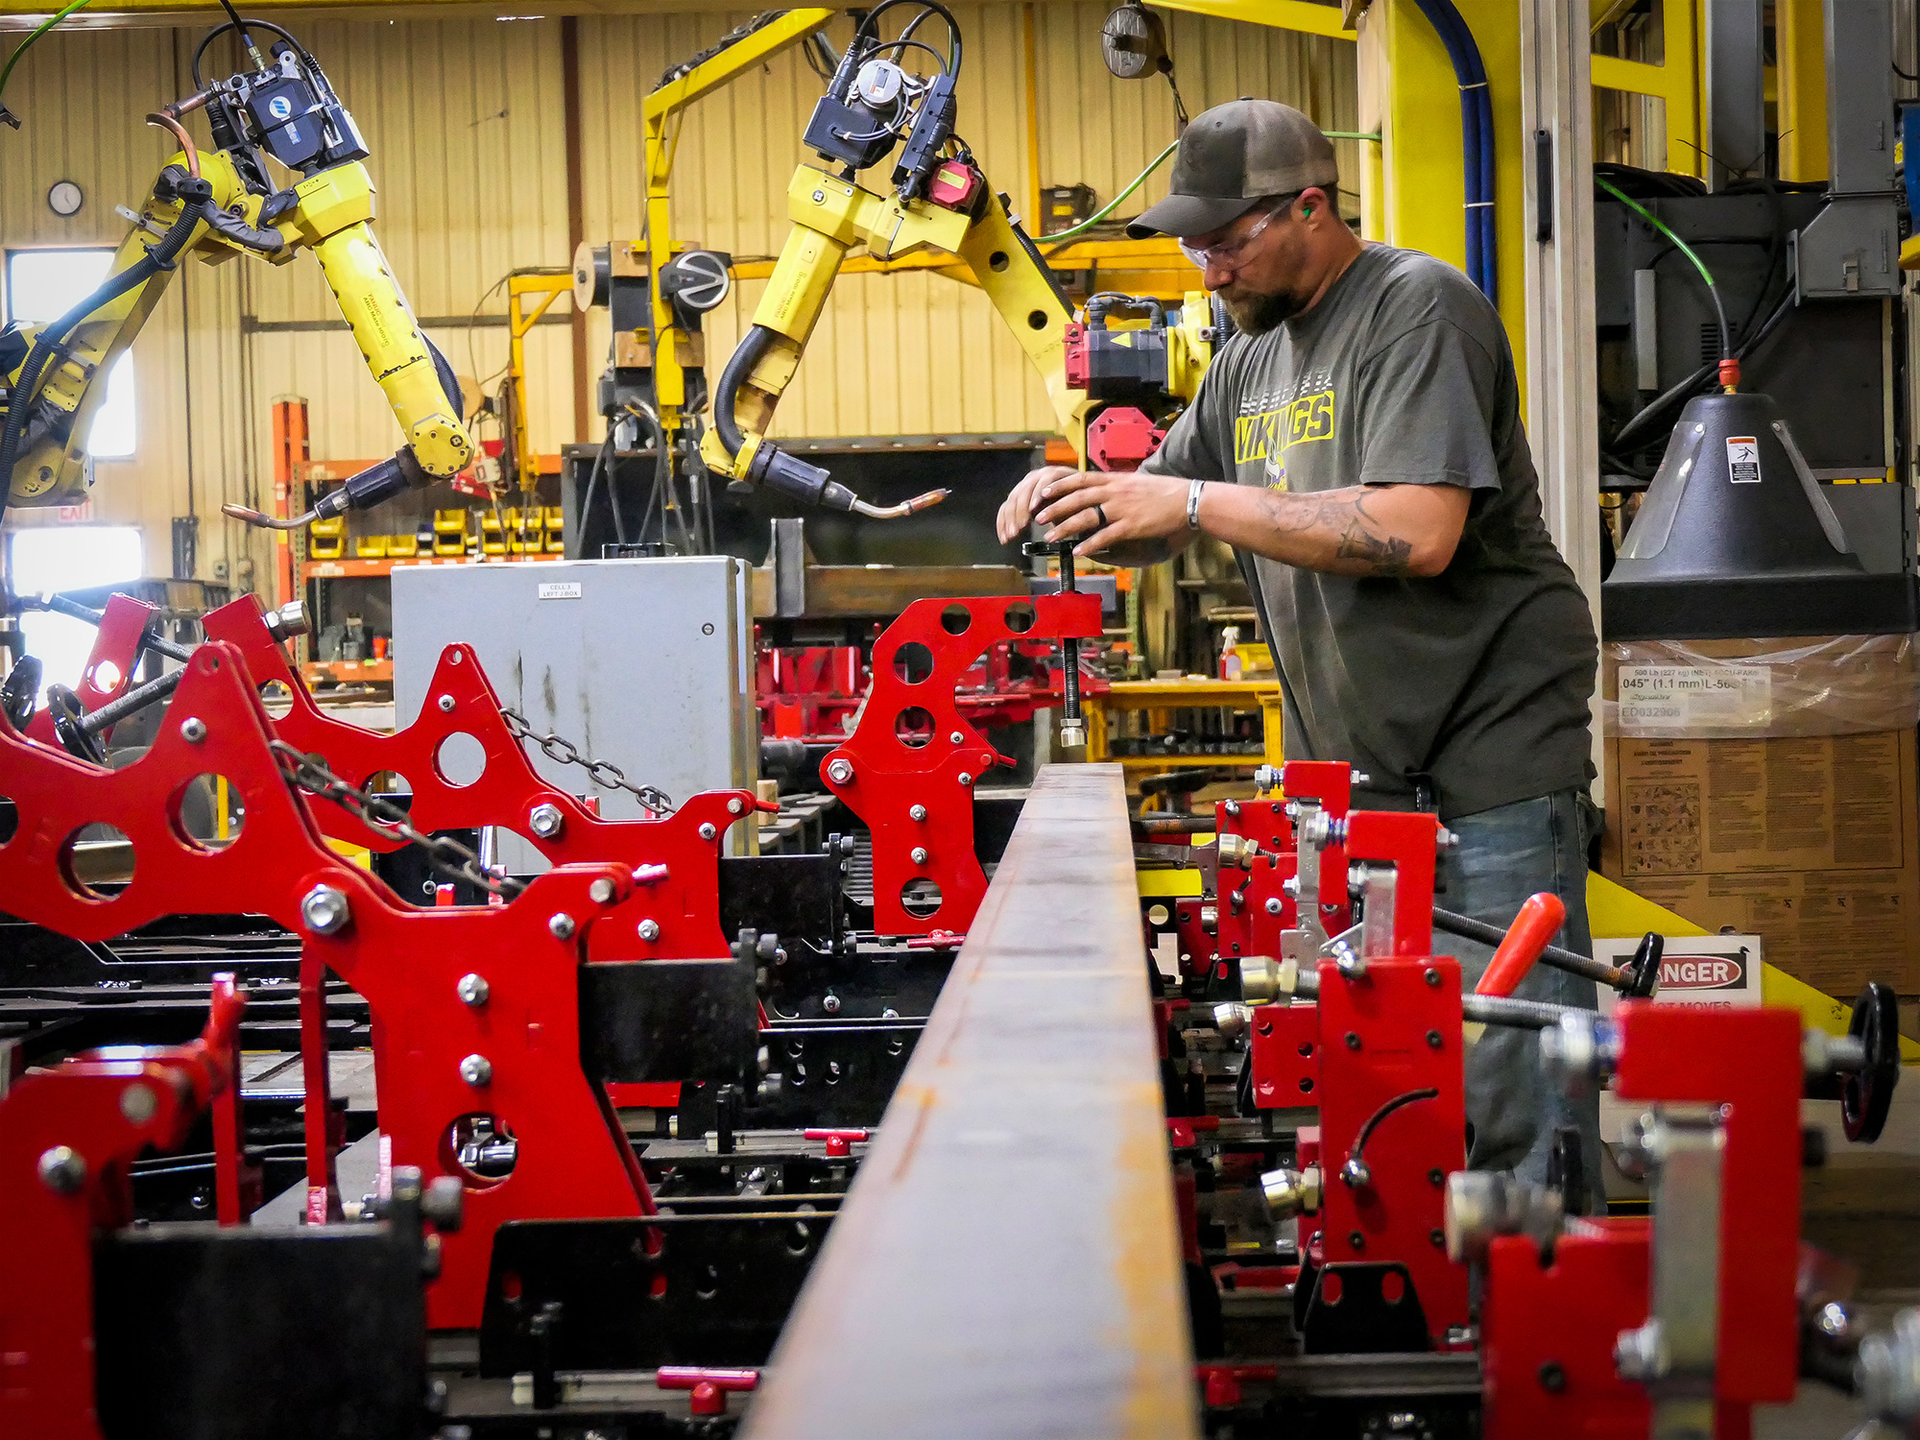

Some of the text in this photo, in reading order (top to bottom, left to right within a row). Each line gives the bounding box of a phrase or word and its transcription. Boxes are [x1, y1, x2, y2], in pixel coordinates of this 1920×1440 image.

[1236, 391, 1334, 464] VIKINGS
[1653, 678, 1674, 690] (1.1
[1658, 963, 1729, 983] NGER
